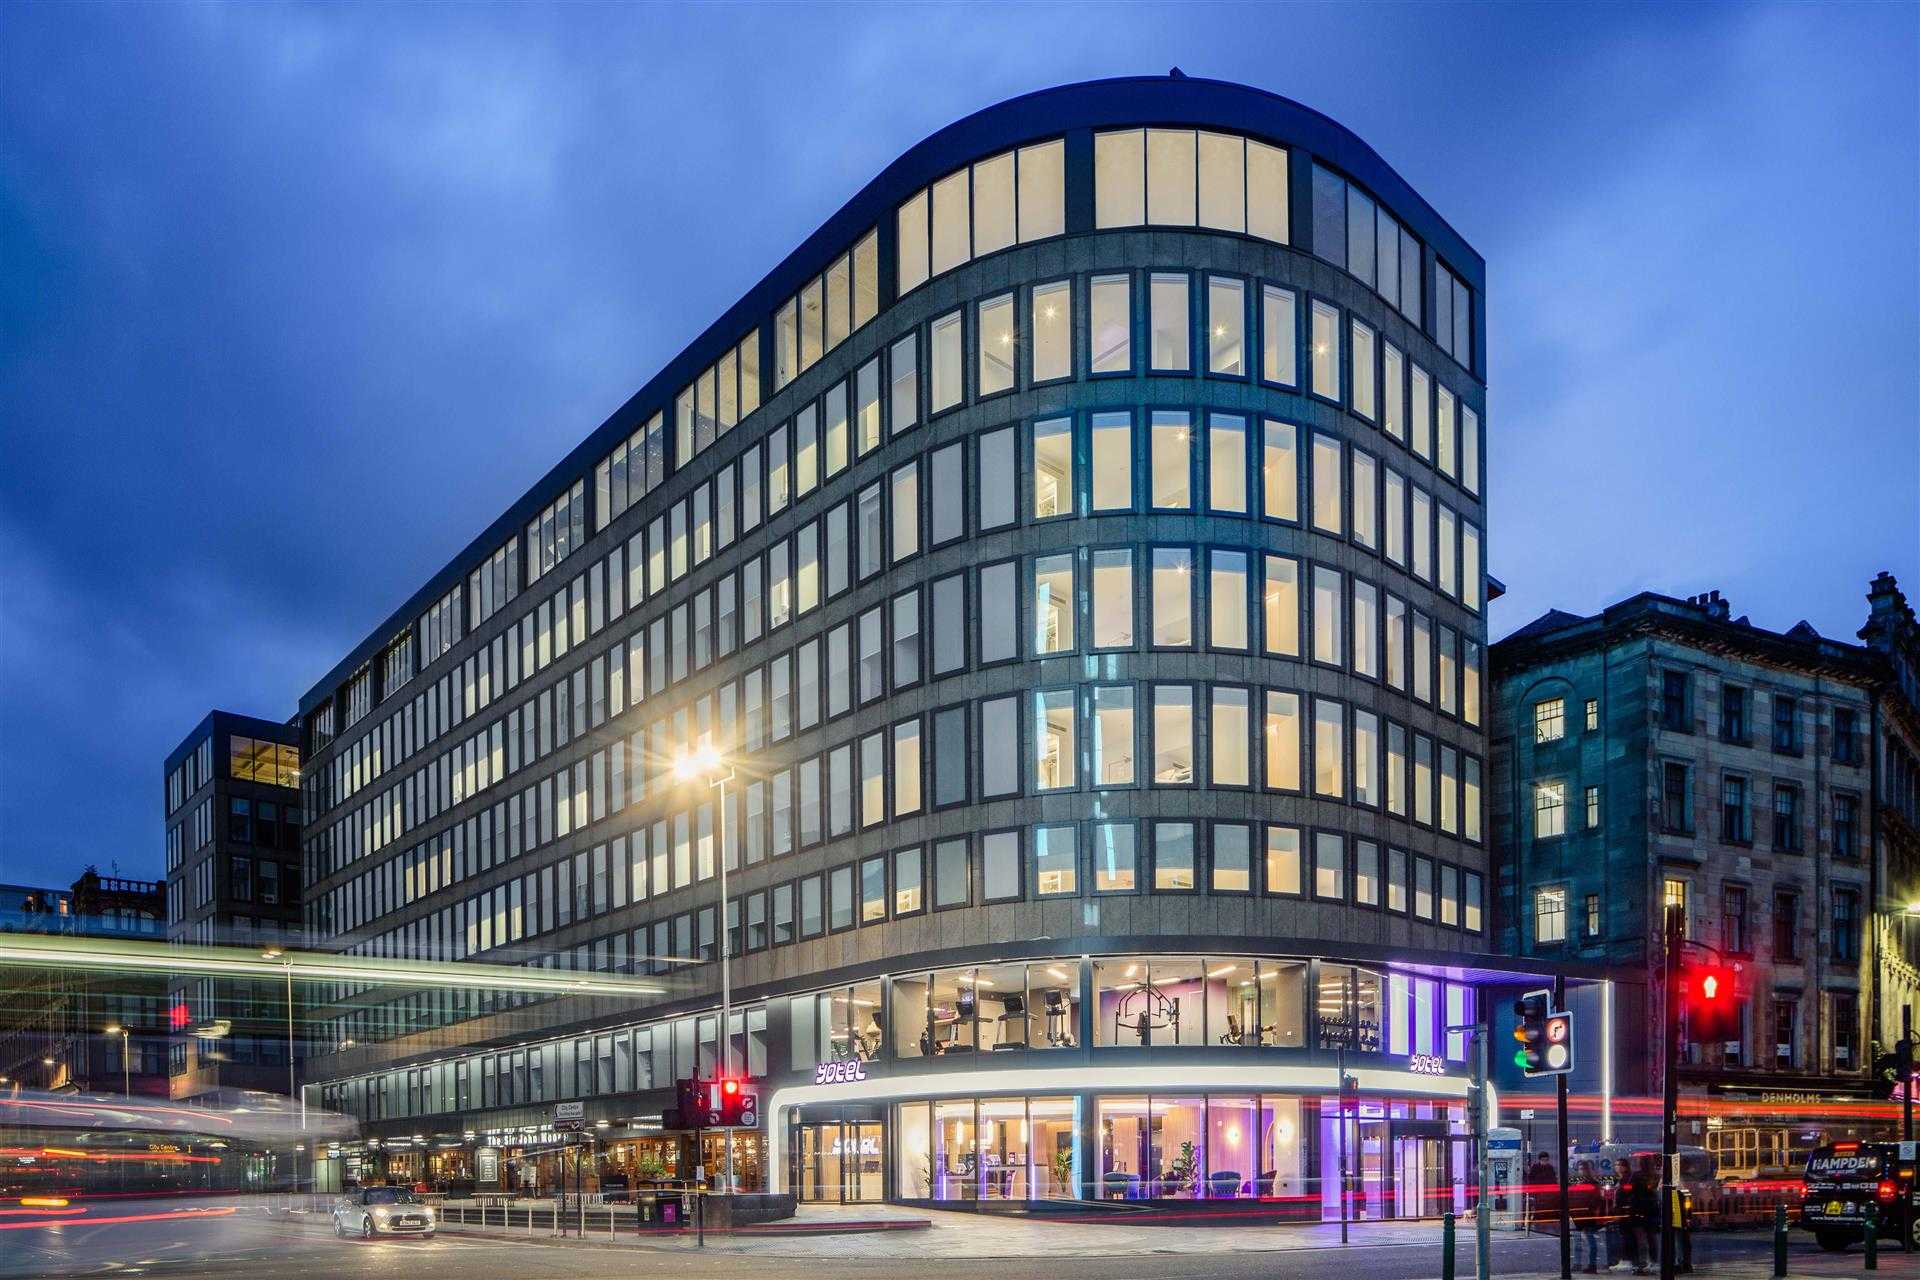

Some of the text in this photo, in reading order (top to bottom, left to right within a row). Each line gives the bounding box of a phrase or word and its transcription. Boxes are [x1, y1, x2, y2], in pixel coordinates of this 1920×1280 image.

[1761, 1092, 1821, 1104] DENHOLMS
[487, 1134, 501, 1146] The
[504, 1134, 516, 1145] Sir
[519, 1133, 538, 1144] John
[1812, 1157, 1877, 1170] HAMPDEN
